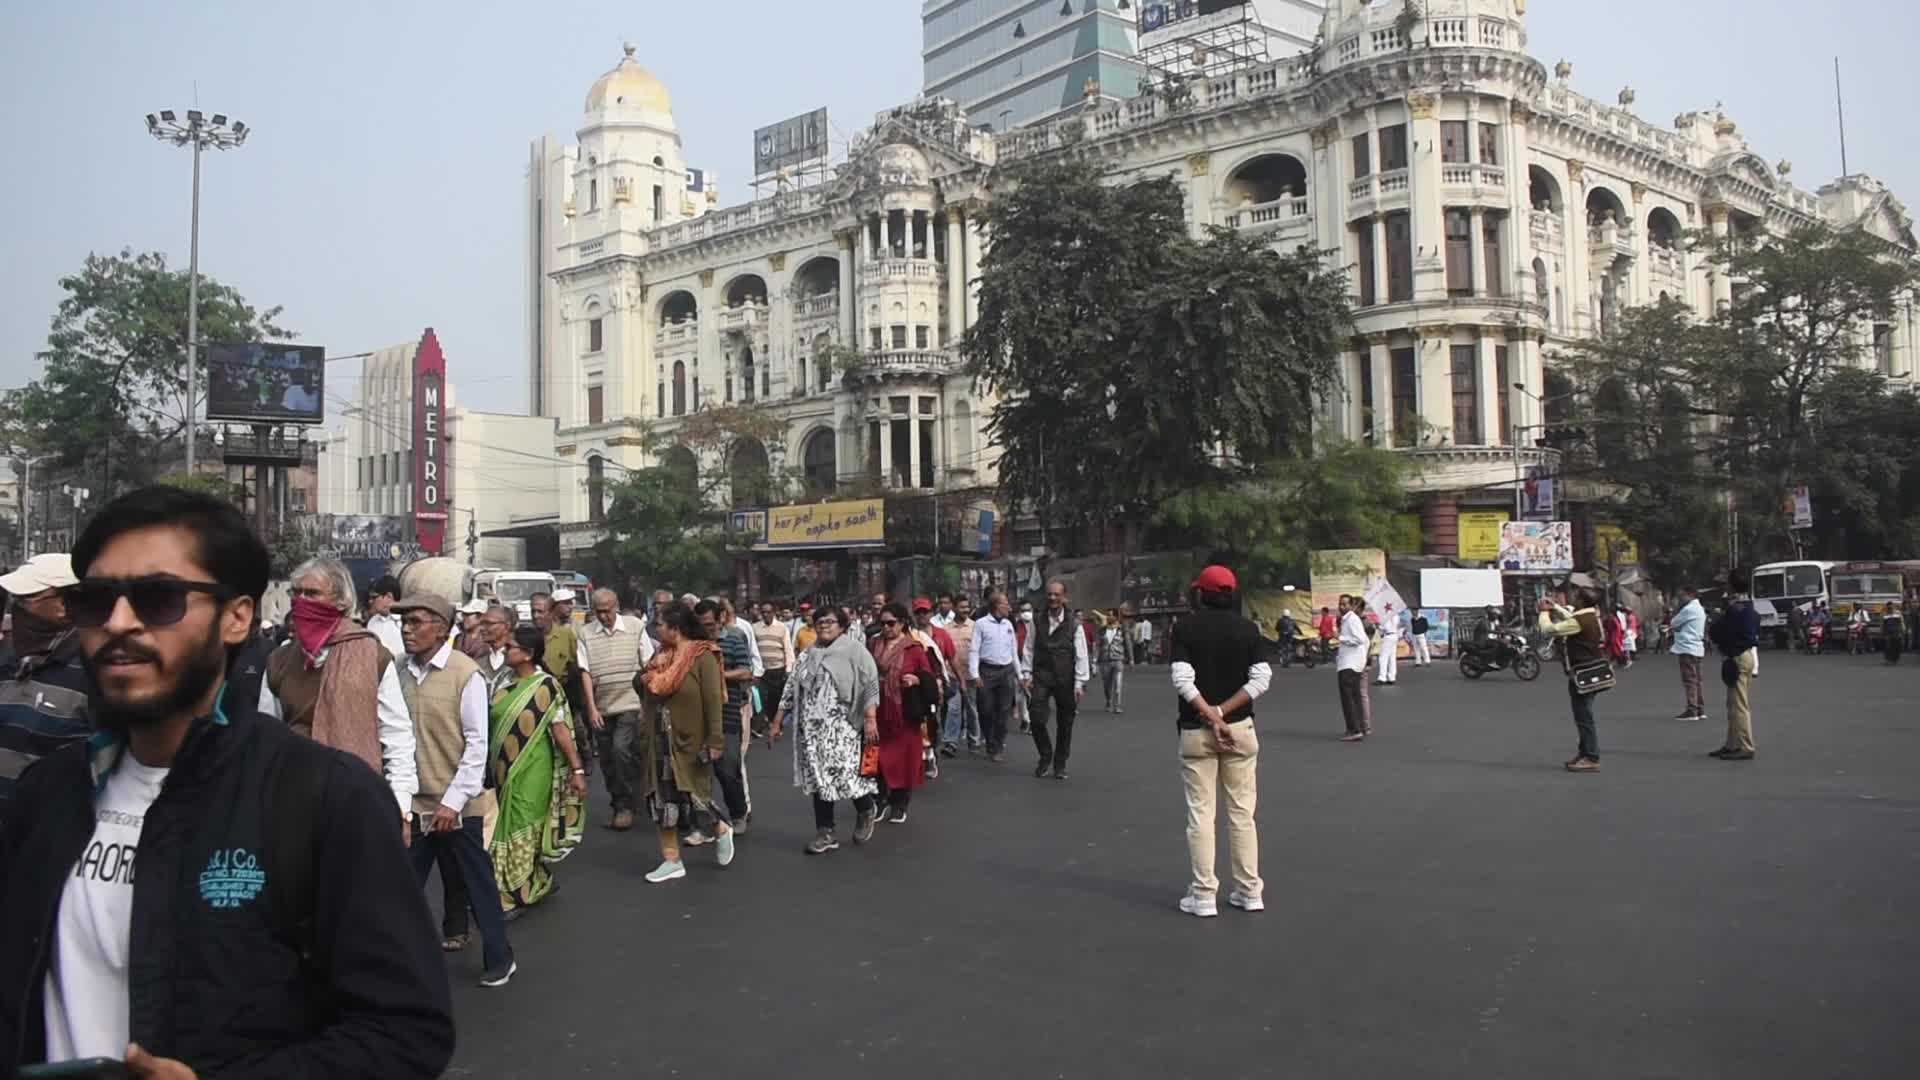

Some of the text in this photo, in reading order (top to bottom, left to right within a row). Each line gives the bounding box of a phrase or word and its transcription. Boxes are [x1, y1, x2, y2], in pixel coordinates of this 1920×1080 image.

[425, 387, 438, 504] METRO
[792, 507, 814, 532] pal
[368, 542, 420, 562] INOX
[75, 841, 137, 885] AOR
